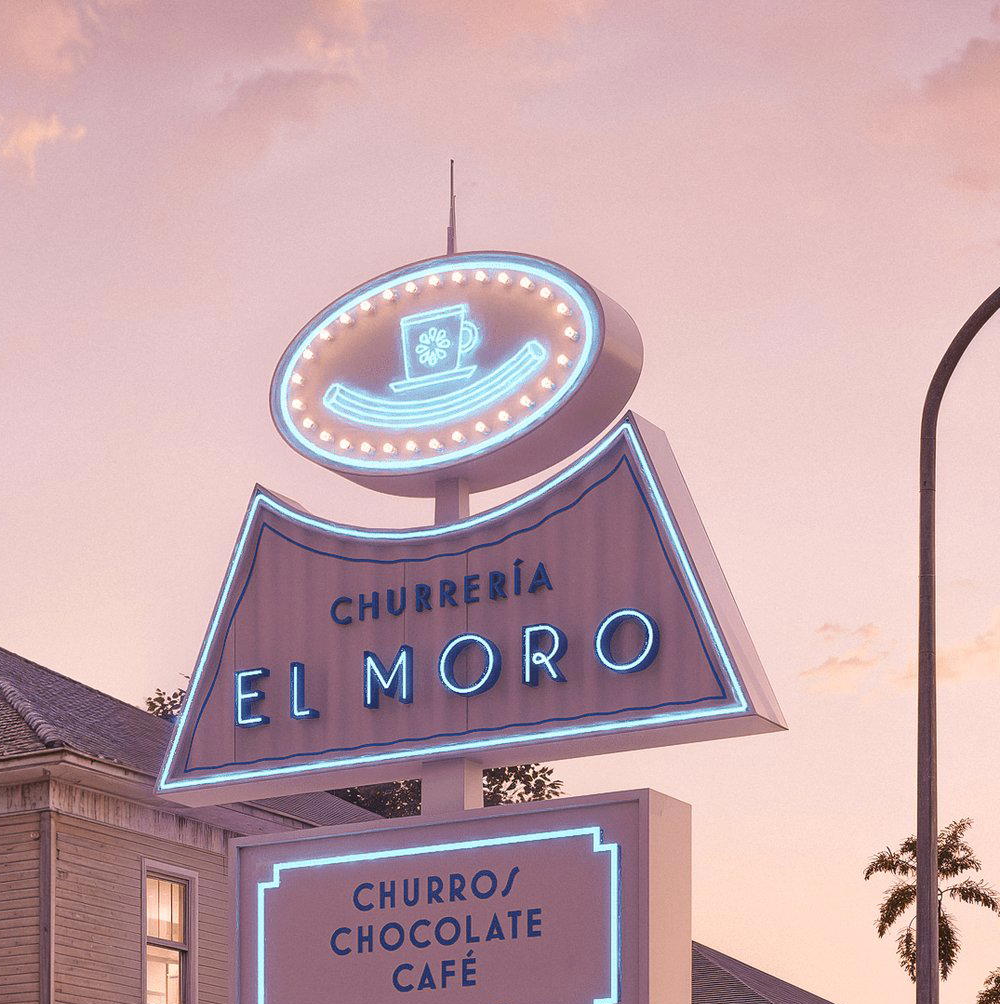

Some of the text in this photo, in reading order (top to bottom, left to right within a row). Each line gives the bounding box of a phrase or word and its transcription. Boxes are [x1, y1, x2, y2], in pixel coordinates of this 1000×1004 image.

[330, 559, 553, 626] CHURRERÍA
[235, 608, 660, 728] EL MORO
[353, 867, 519, 911] CHURROS
[330, 908, 541, 955] CHOCOLATE
[392, 949, 476, 992] CAFÉ
